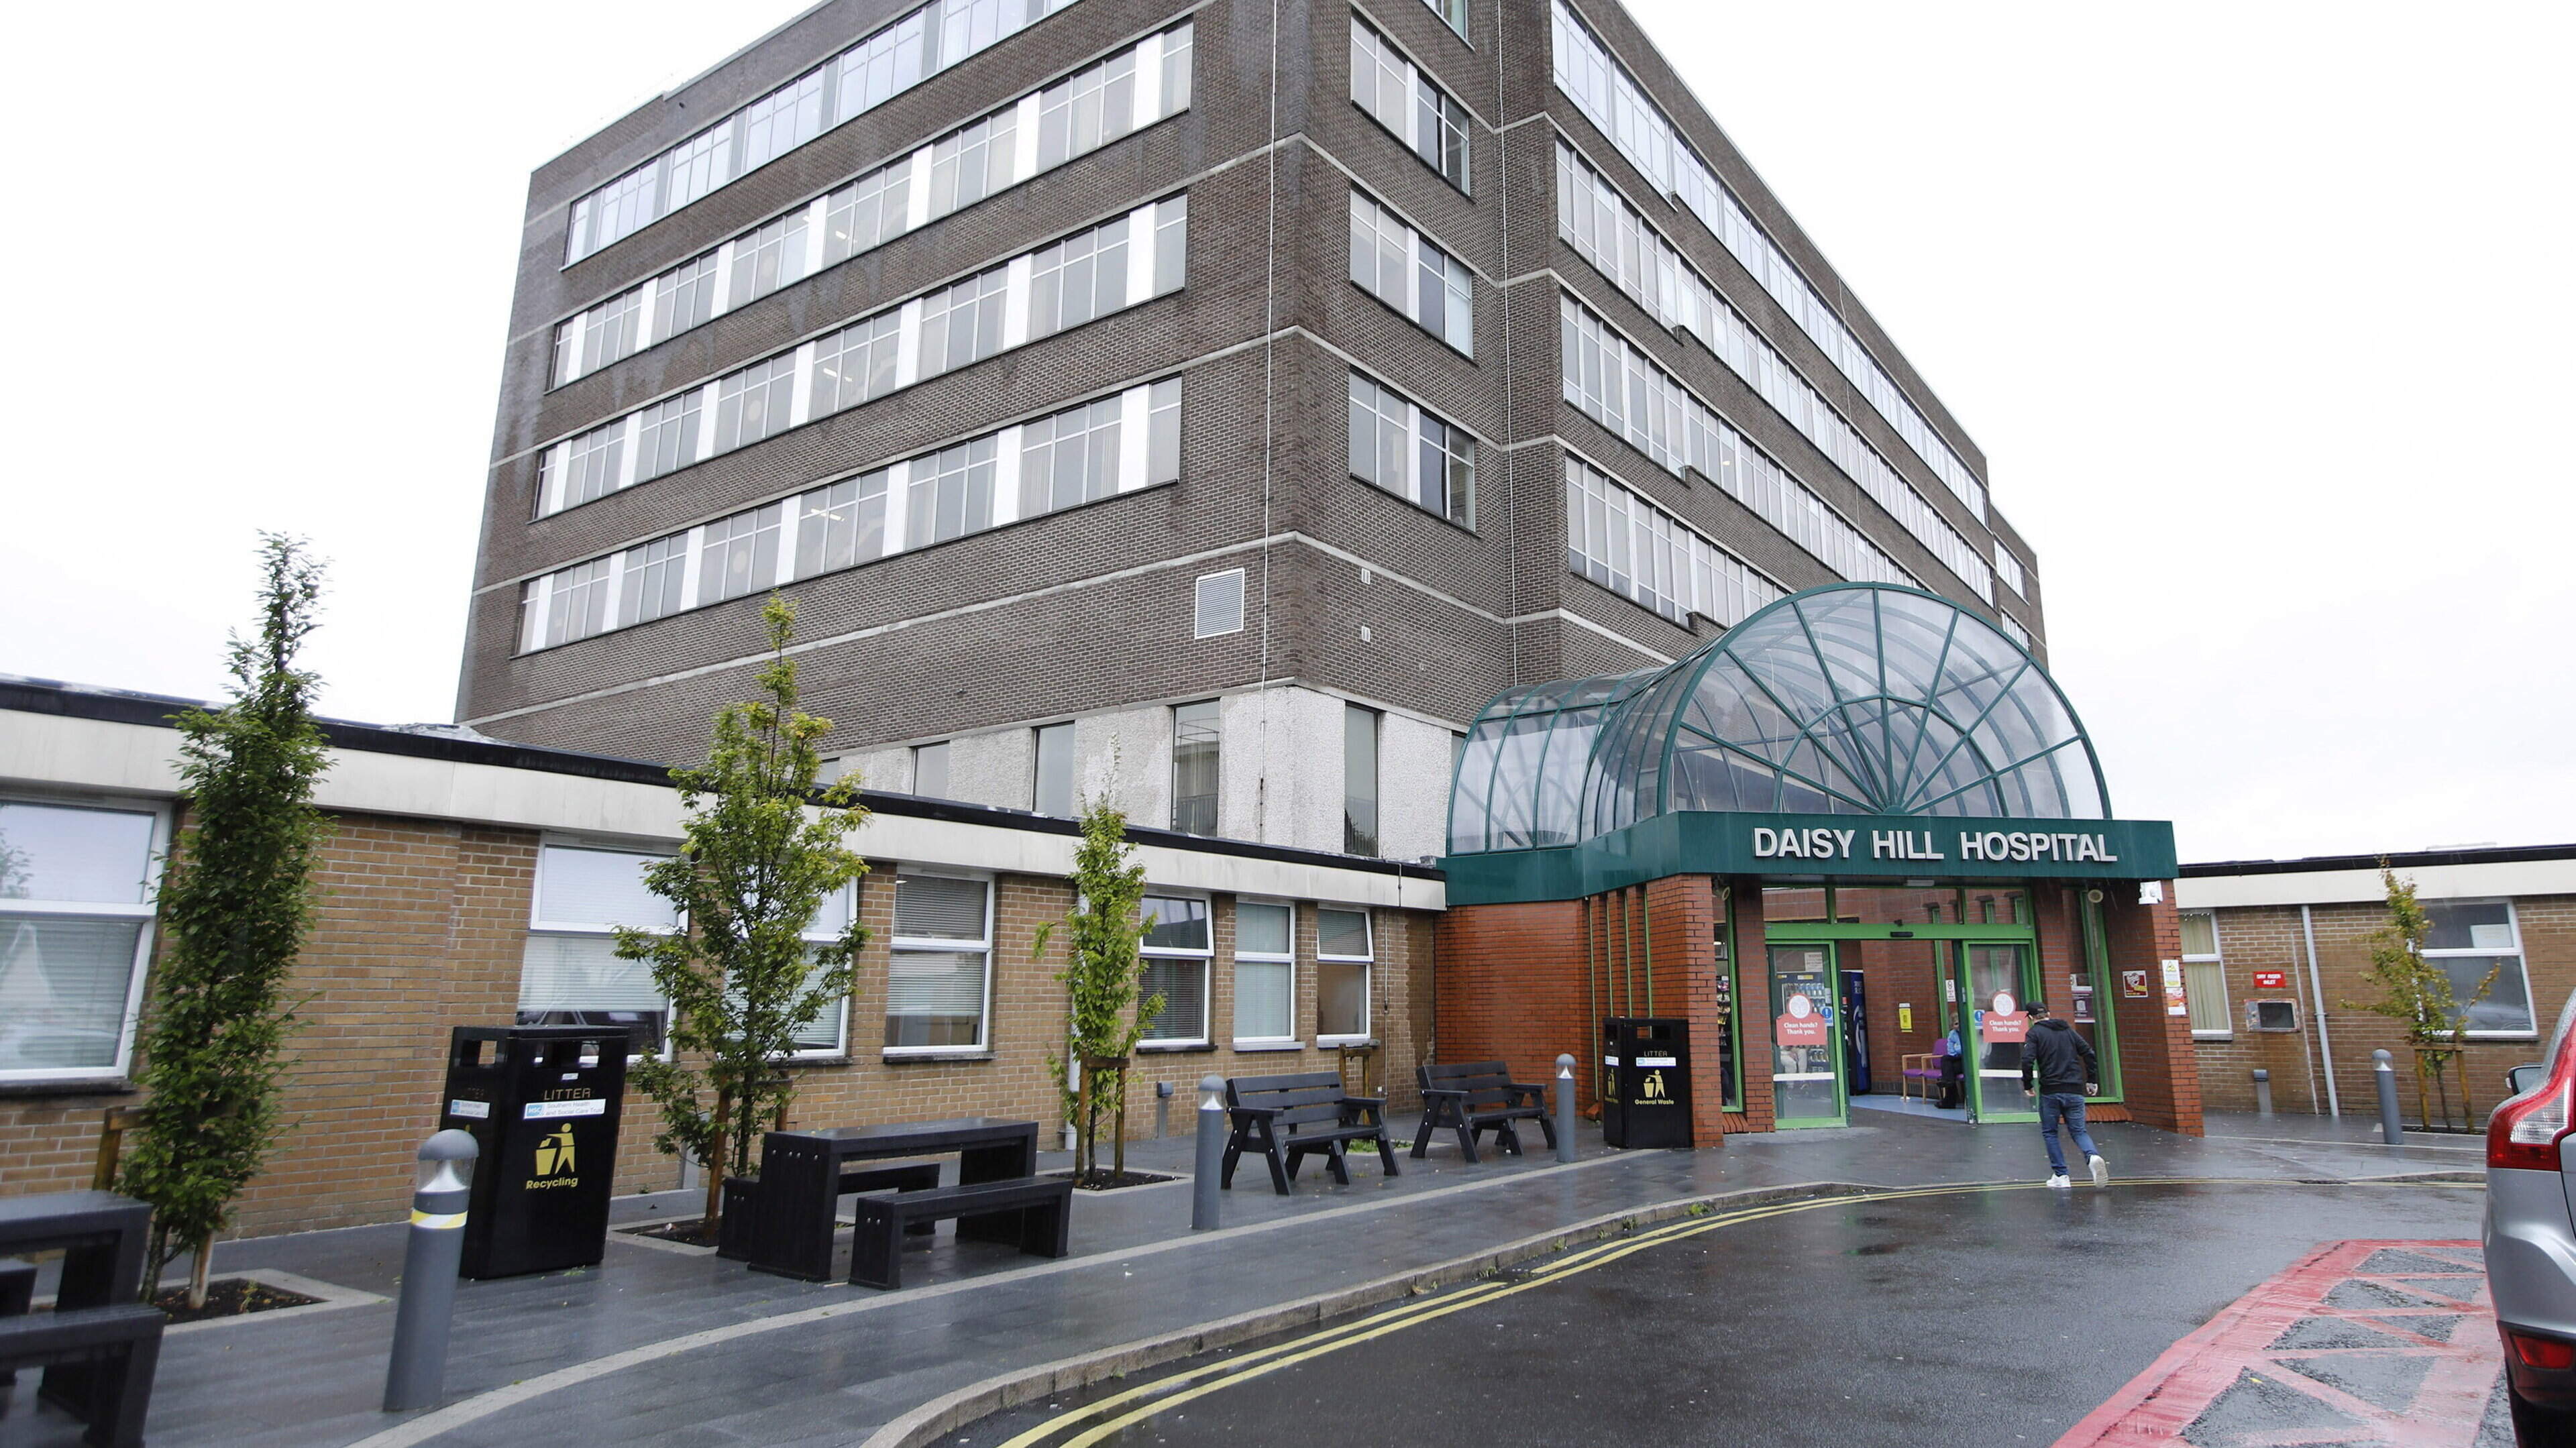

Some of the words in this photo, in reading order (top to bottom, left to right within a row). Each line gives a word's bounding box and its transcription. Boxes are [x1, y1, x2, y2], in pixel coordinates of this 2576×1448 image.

[1754, 828, 1856, 859] DAISY
[1872, 829, 1944, 860] HILL
[1959, 831, 2118, 862] HOSPITAL
[544, 1088, 591, 1101] LITTER
[526, 1176, 578, 1190] Recycling
